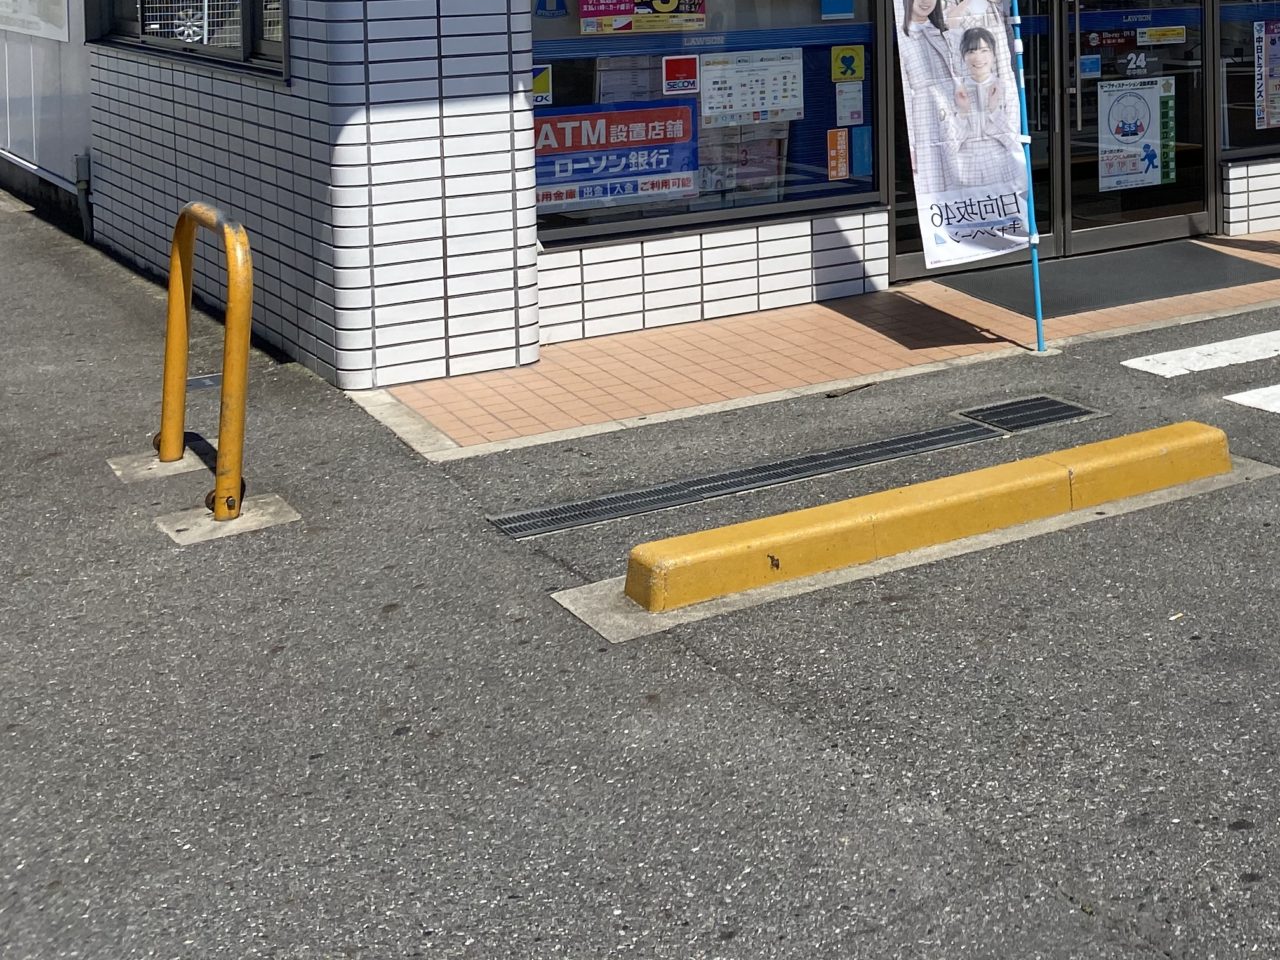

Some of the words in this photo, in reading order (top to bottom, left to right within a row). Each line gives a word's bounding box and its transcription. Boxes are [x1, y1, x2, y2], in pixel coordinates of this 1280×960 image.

[1127, 52, 1147, 69] 24
[1255, 36, 1264, 99] 中日ドラゴンズ
[666, 80, 696, 90] SECOM
[554, 149, 670, 178] ローソン銀行
[583, 184, 604, 198] 出金
[614, 182, 634, 195] 入金
[640, 176, 692, 192] ご利用可能
